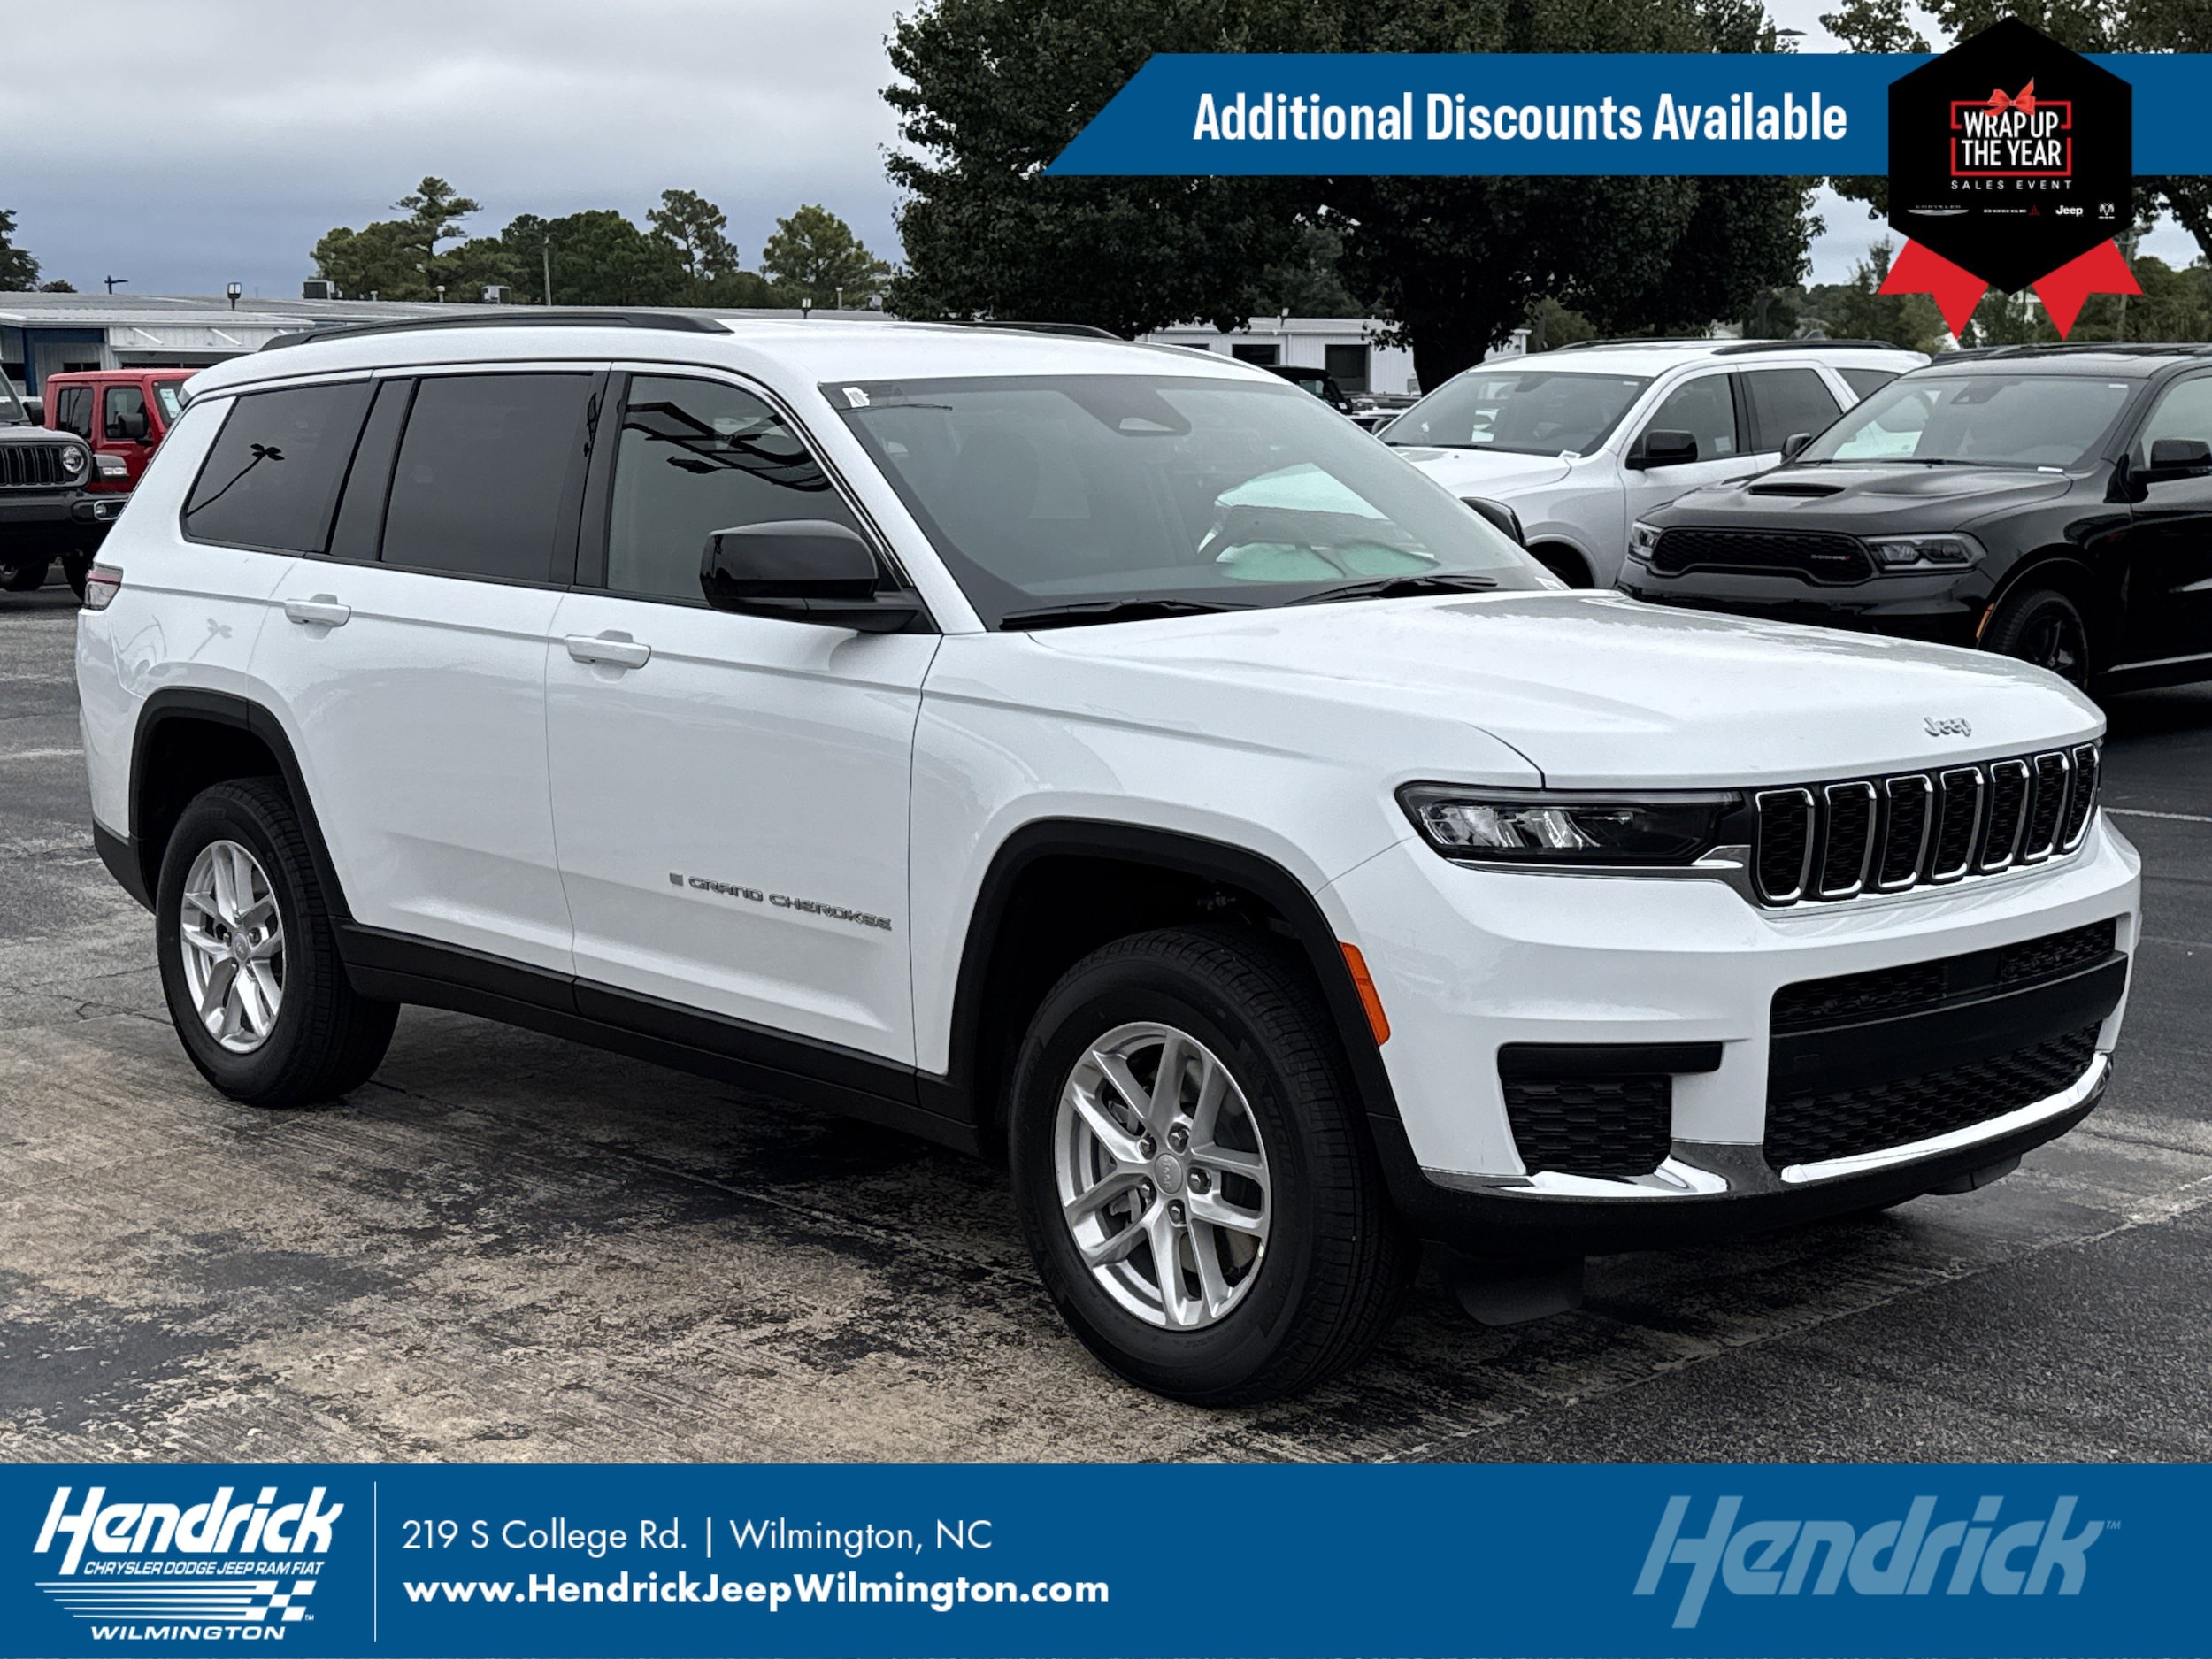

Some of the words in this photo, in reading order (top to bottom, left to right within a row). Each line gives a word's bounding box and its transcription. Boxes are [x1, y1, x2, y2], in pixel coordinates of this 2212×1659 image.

[1924, 717, 1971, 737] Jeep
[688, 876, 764, 902] GRAND
[769, 893, 892, 931] CHEROKEE
